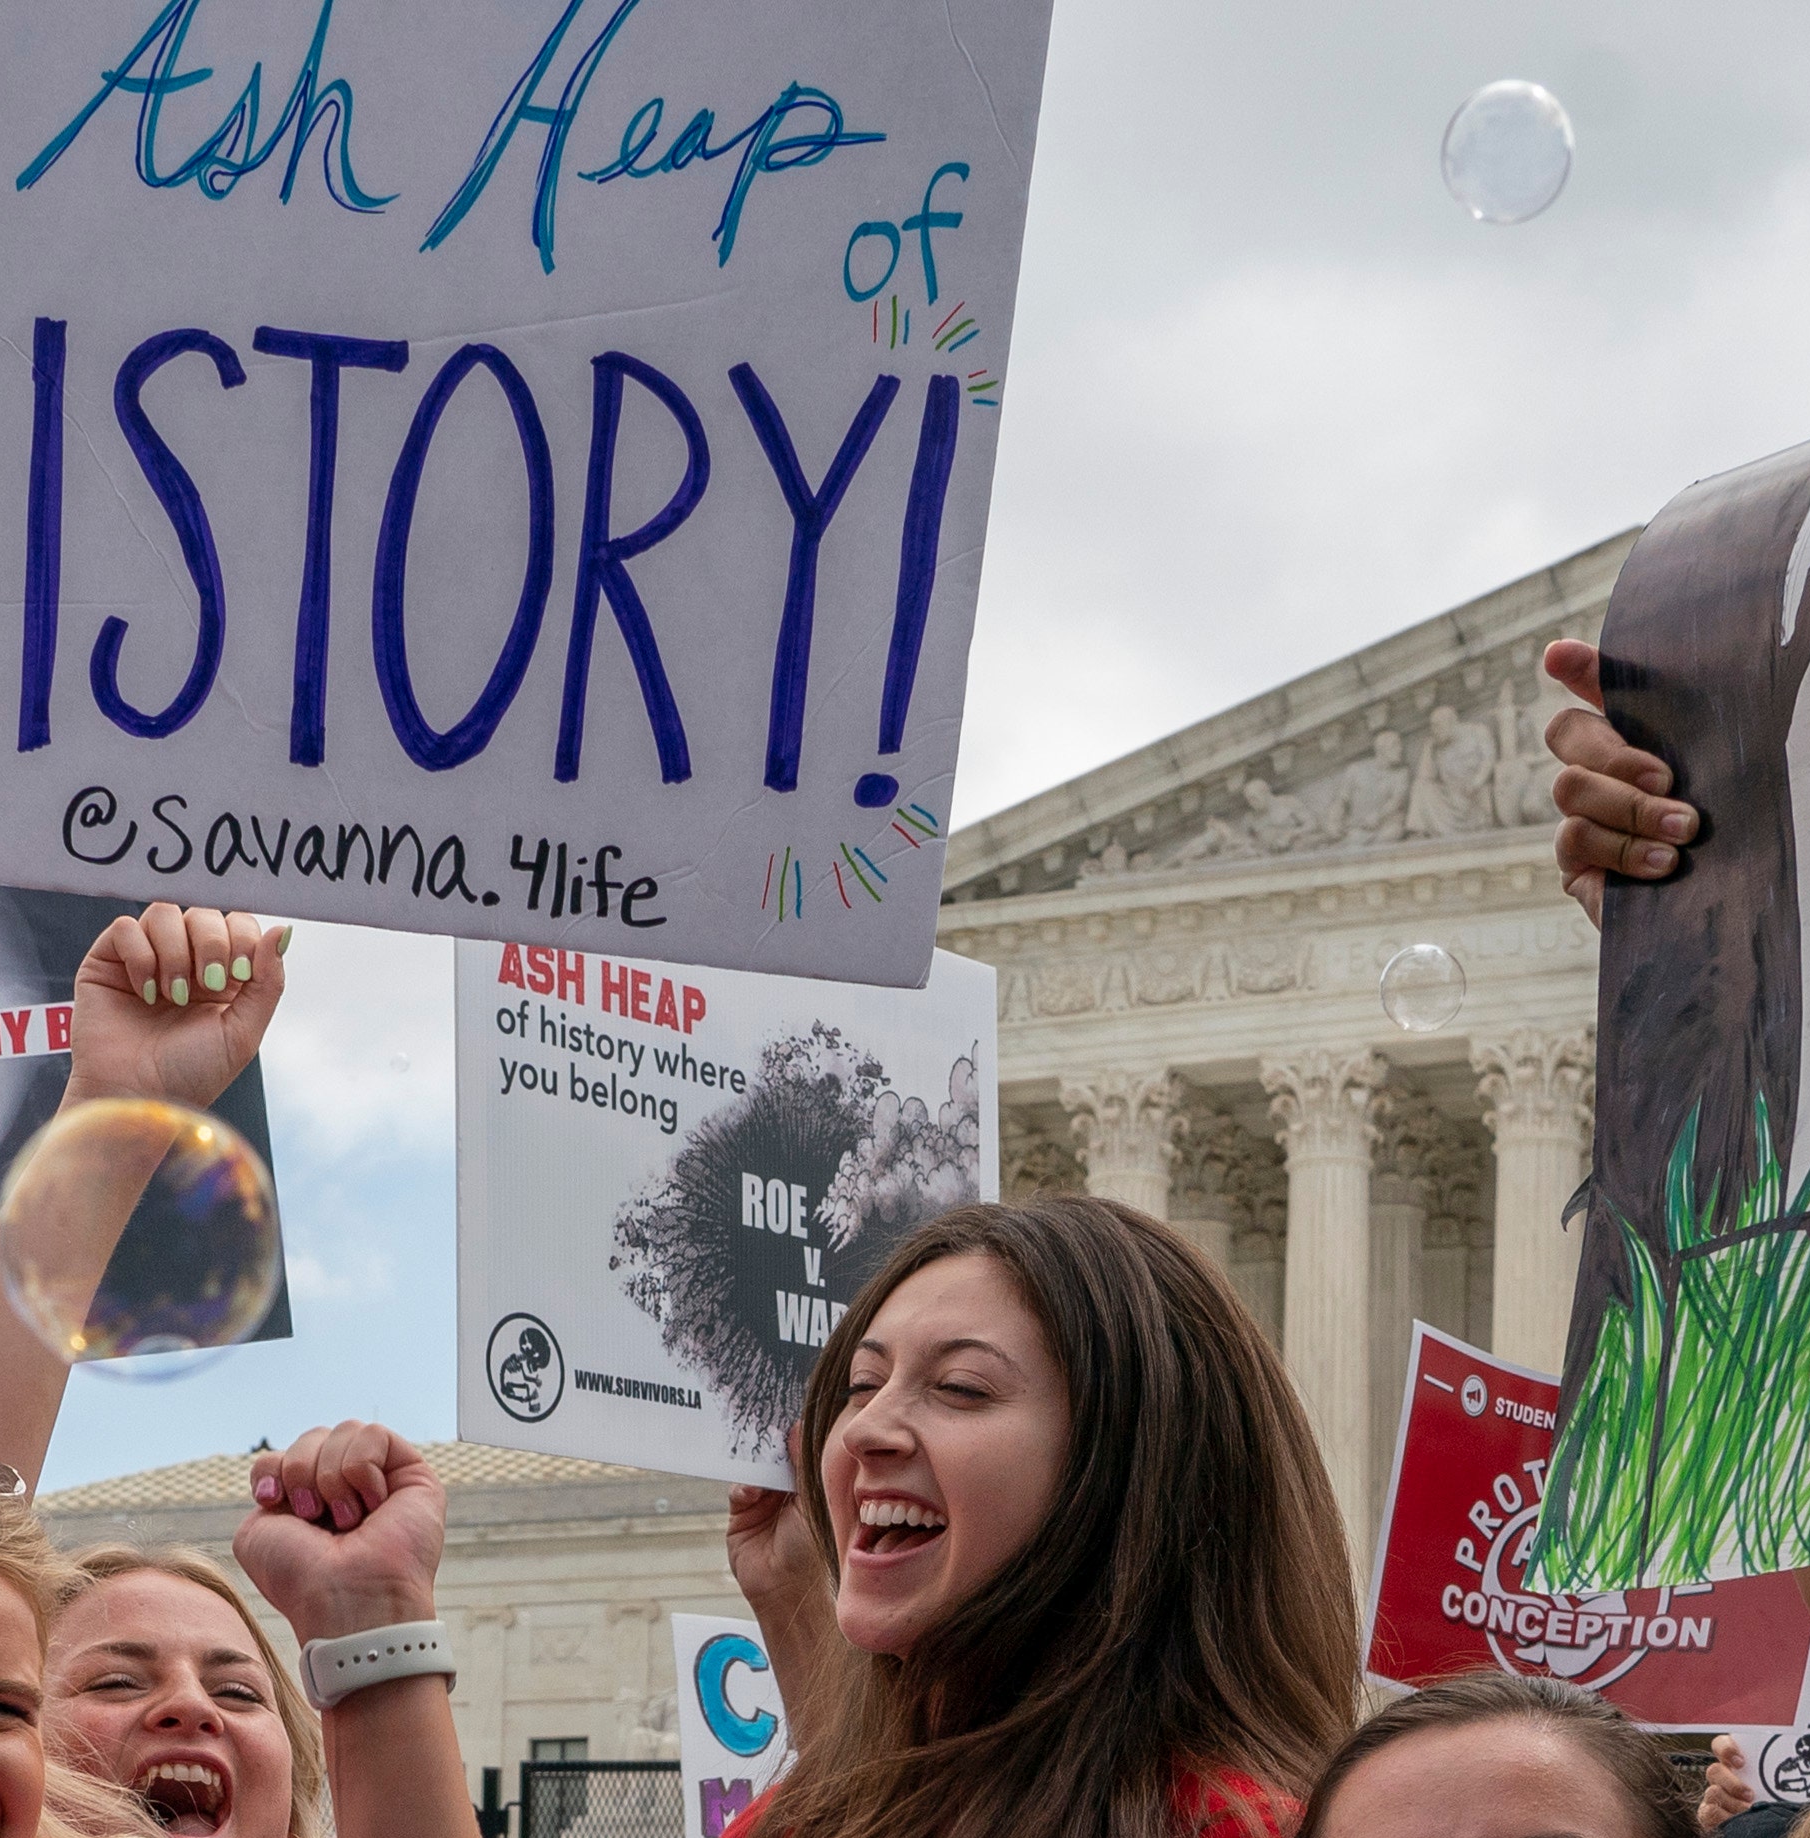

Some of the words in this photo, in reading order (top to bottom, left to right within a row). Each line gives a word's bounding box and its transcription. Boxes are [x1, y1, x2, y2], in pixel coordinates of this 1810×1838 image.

[15, 0, 400, 213] Ash
[419, 0, 887, 274] Heap
[842, 163, 967, 305] of
[497, 942, 586, 1006] ASH
[601, 961, 707, 1035] HEAP
[496, 1000, 529, 1039] of
[540, 1010, 646, 1078] history
[653, 1043, 747, 1095] where
[499, 1056, 559, 1096] you
[570, 1069, 679, 1135] belong
[741, 1172, 809, 1241] ROE
[803, 1246, 826, 1288] V.
[574, 1369, 702, 1410] WWW.SURVIVORS.LA
[1441, 1584, 1714, 1649] CONCEPTION
